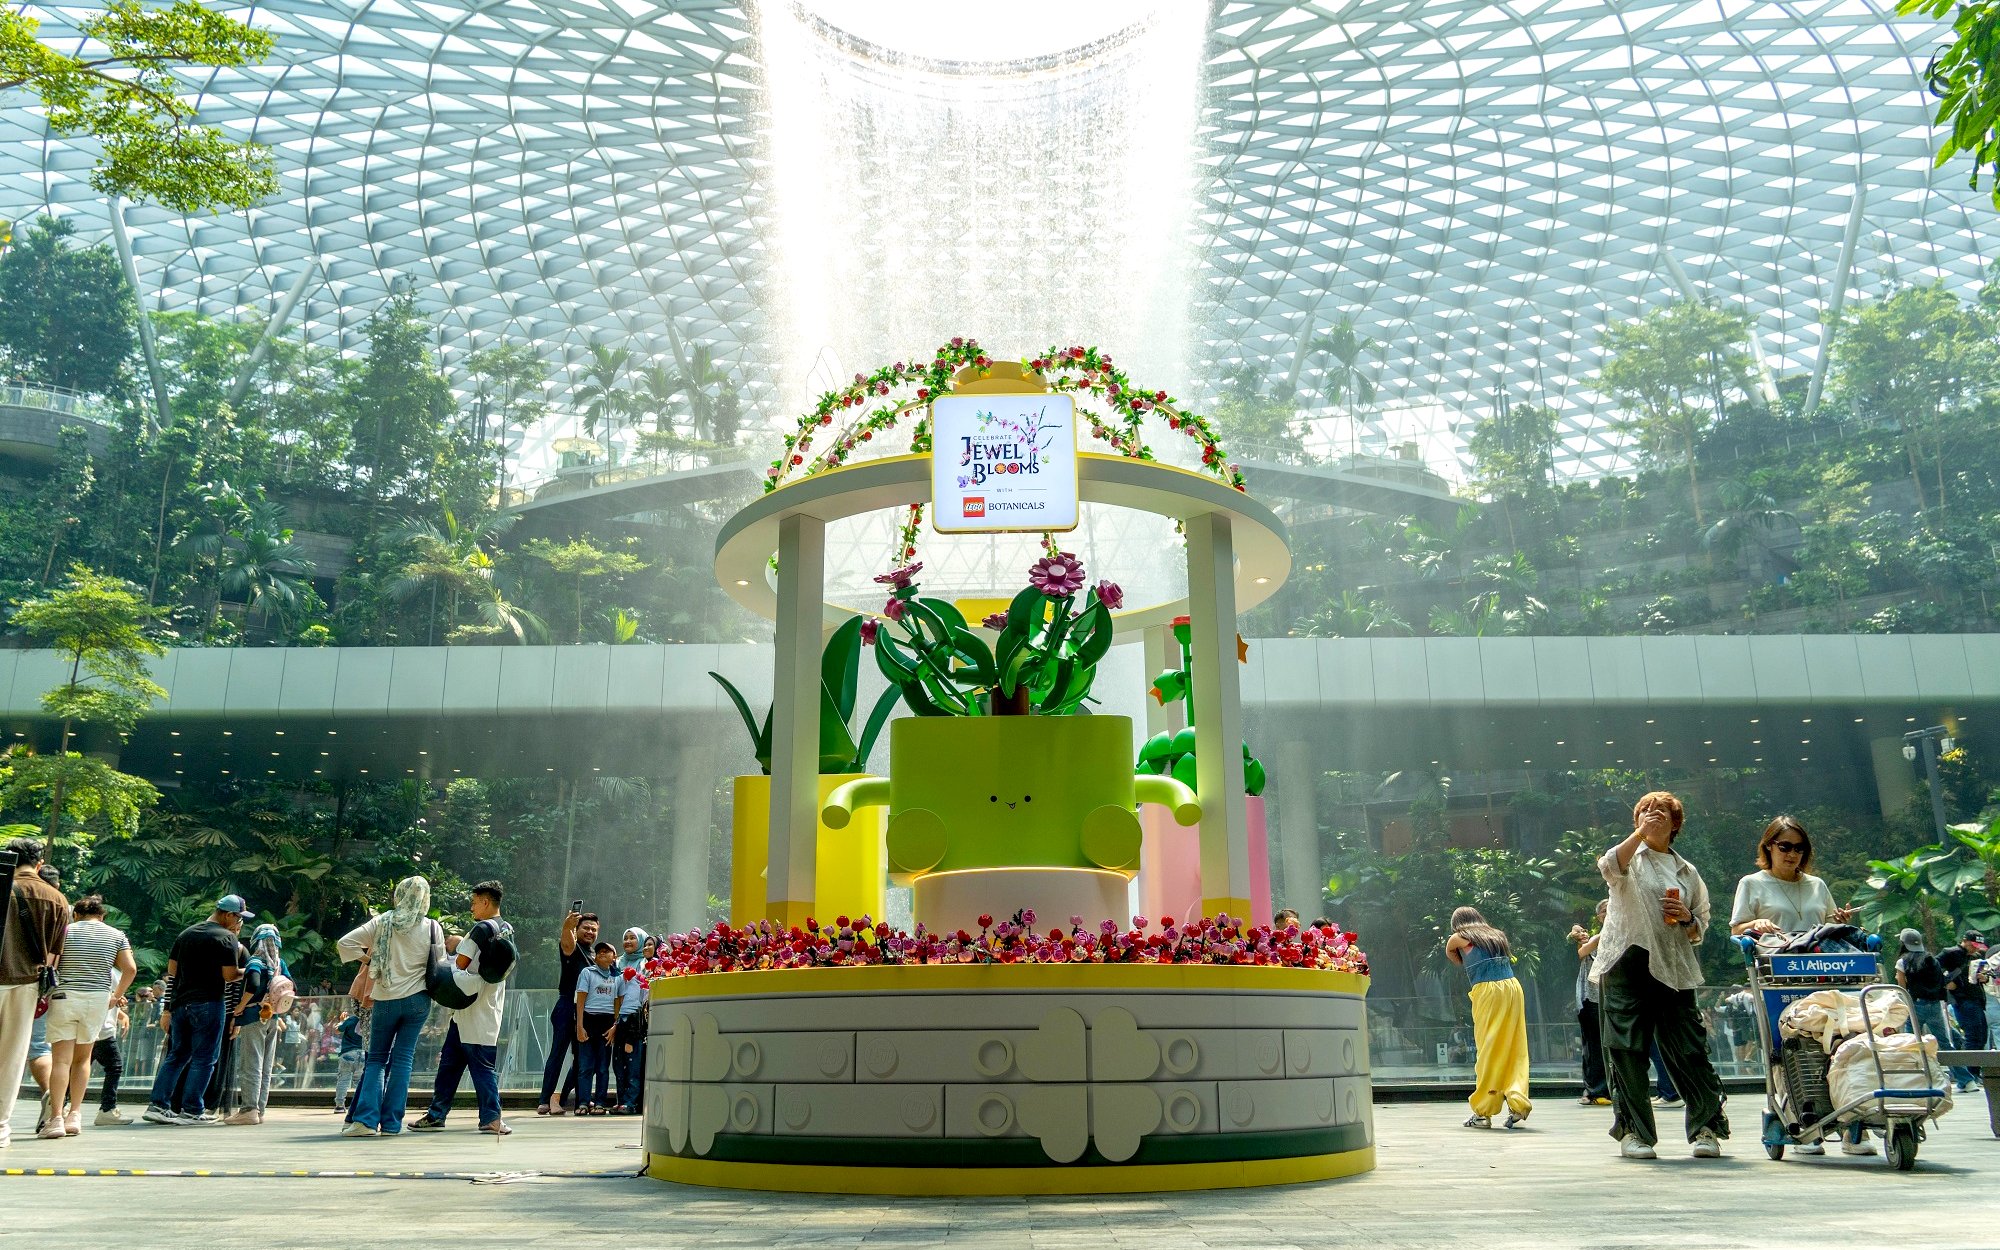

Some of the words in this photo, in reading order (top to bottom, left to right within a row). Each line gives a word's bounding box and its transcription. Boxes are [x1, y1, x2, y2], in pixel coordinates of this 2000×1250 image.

[960, 436, 1023, 466] JEWEL
[974, 462, 1040, 484] BLOOMS
[964, 502, 983, 512] LEGO
[988, 501, 1045, 511] BOTANICALS
